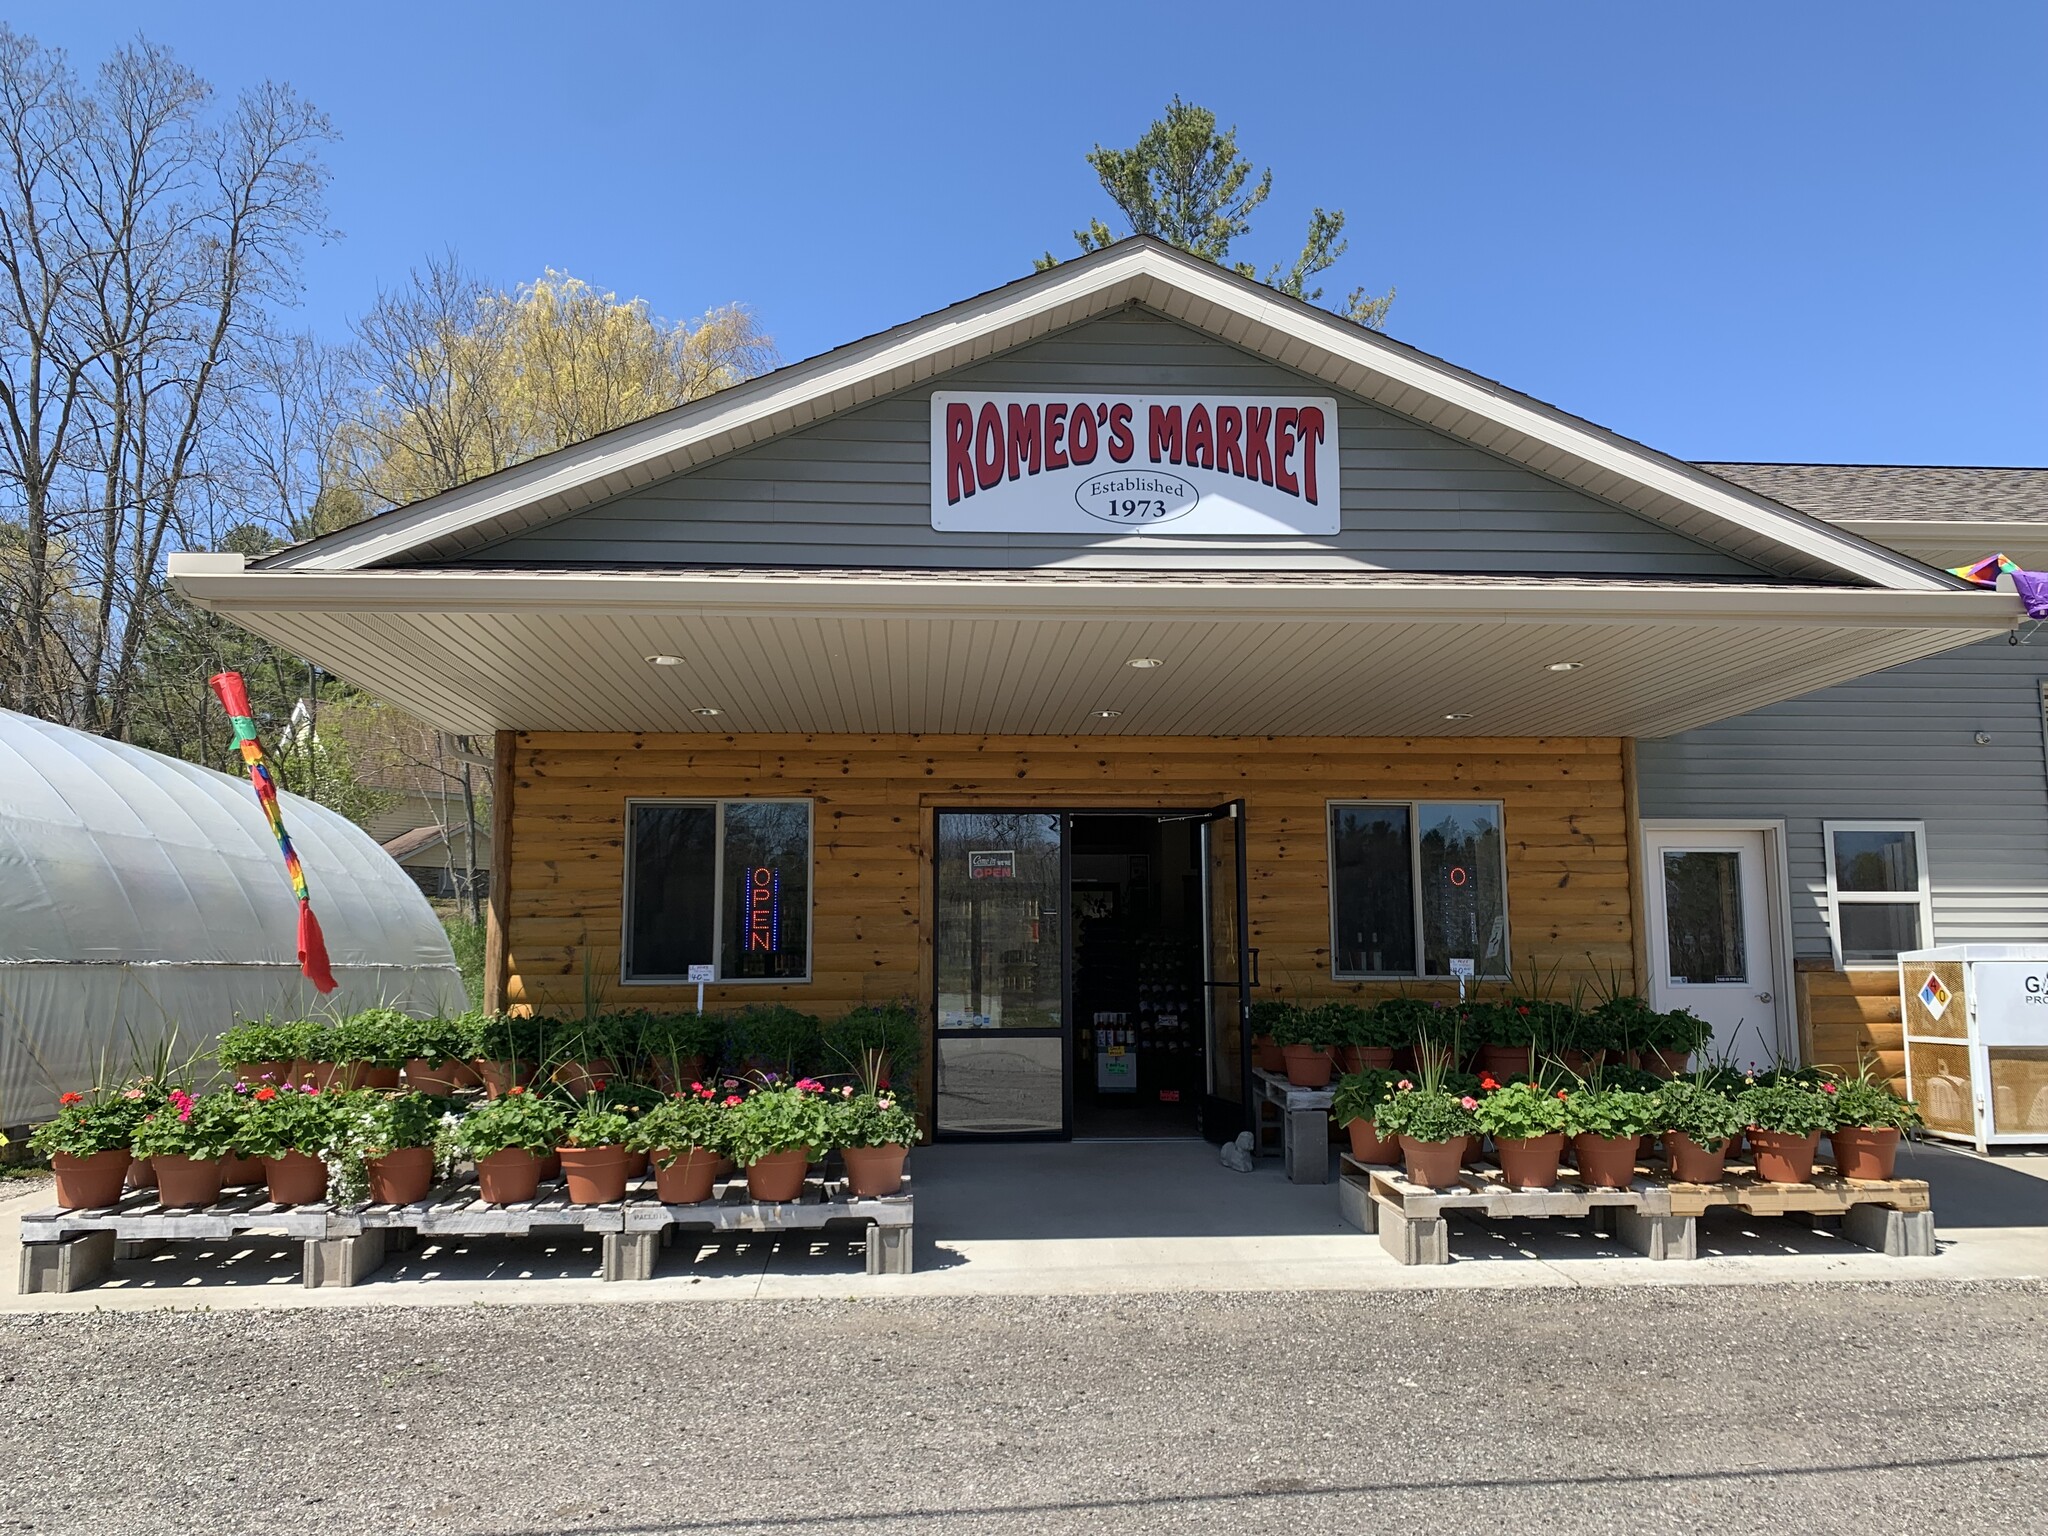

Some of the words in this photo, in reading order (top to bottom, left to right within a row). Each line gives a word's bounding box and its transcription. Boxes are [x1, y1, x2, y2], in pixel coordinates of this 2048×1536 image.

[946, 401, 1134, 506] ROMEO'S
[1148, 402, 1325, 506] MARKET
[1090, 478, 1184, 497] Established
[1108, 499, 1166, 518] 1973
[973, 867, 1011, 879] OPEN
[752, 867, 770, 951] OPEN
[1930, 978, 1937, 991] 4
[1938, 989, 1946, 1002] 0
